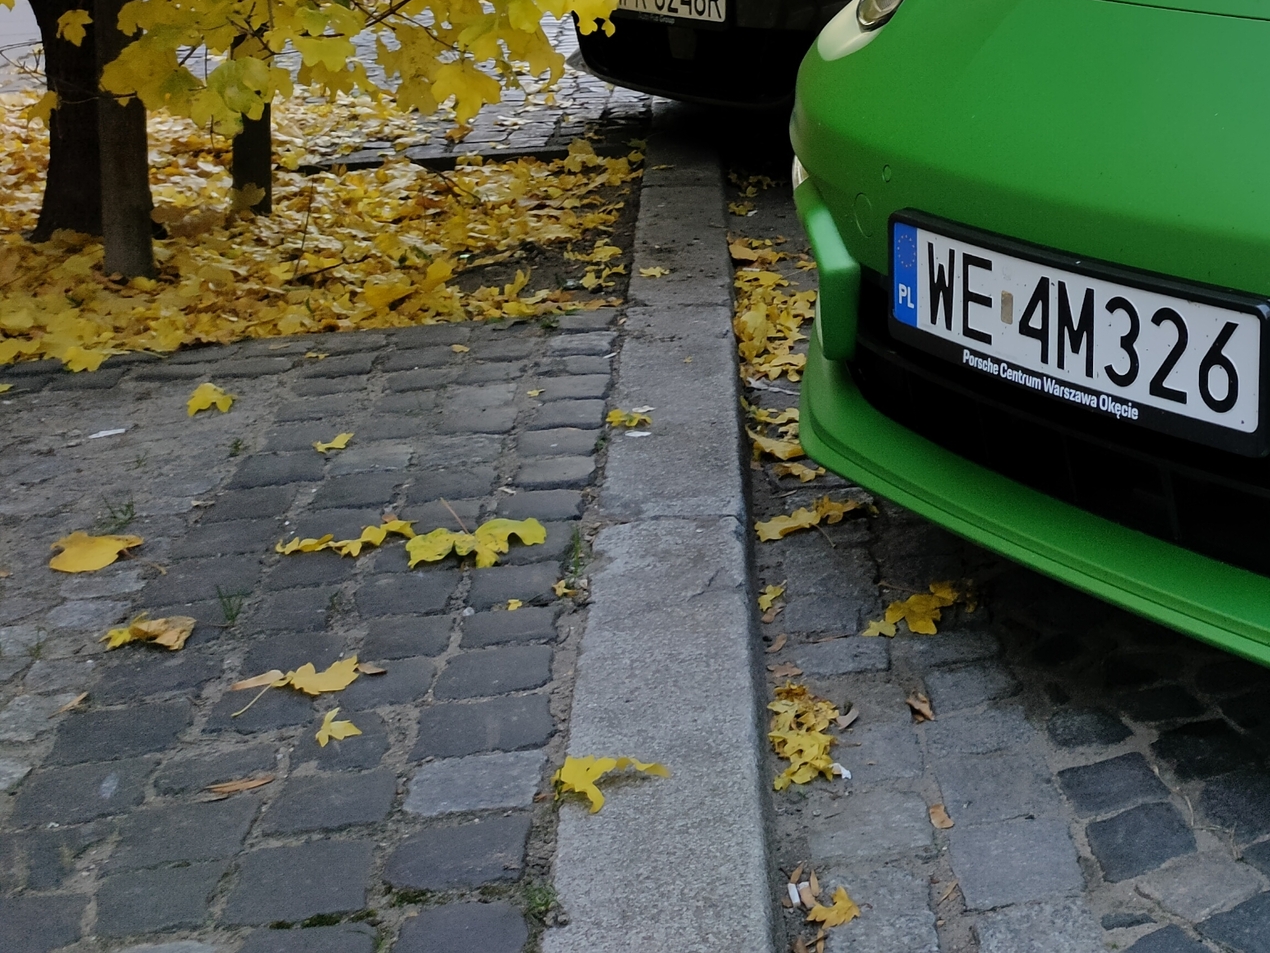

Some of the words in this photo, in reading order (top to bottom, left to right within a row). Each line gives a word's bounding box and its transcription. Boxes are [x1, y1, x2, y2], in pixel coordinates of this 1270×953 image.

[898, 284, 915, 309] PL
[927, 242, 993, 345] WE
[1018, 276, 1240, 413] 4M326
[963, 350, 1000, 376] Porsche
[1000, 362, 1042, 390] Centrum
[1043, 376, 1098, 408] Warszawa
